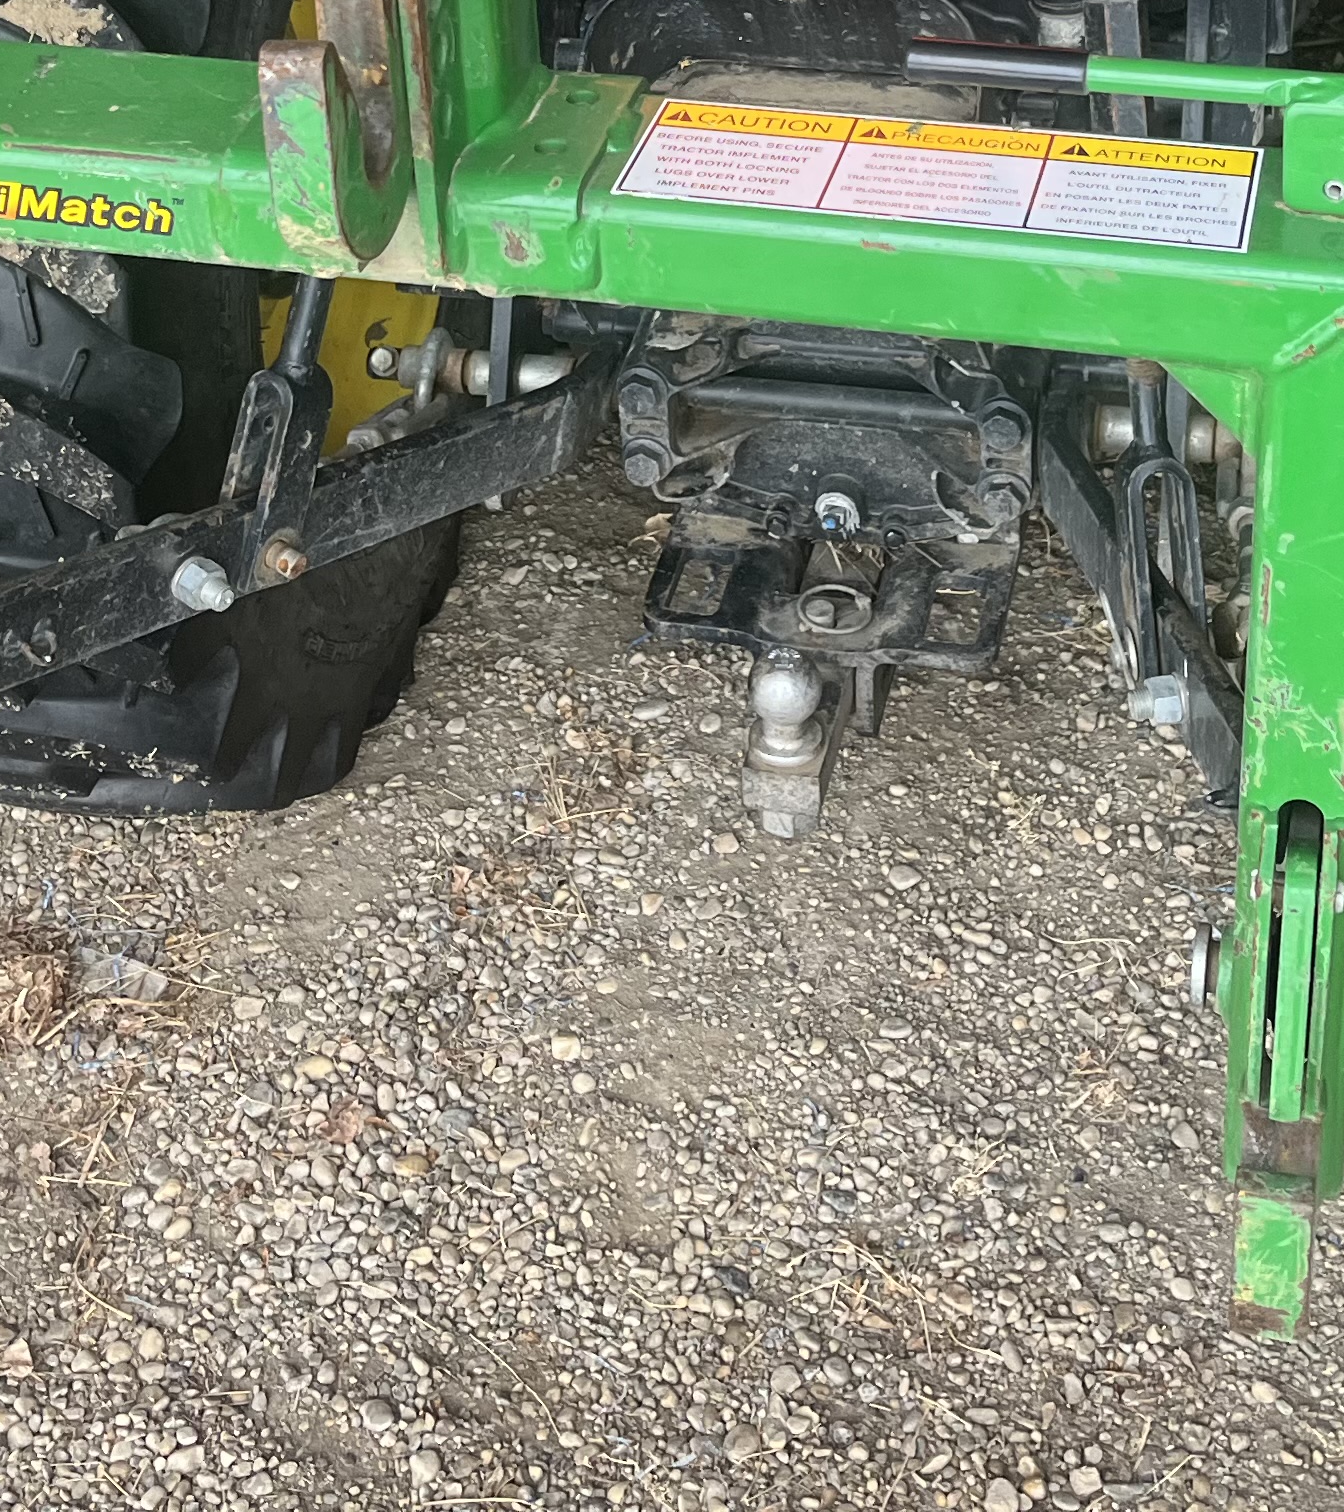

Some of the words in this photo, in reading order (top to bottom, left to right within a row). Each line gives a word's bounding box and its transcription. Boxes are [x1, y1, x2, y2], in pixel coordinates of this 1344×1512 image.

[698, 112, 832, 134] CAUTION
[657, 132, 712, 143] BEFORE
[766, 142, 824, 153] SECURE
[891, 131, 1040, 151] PRECAUCIÓN
[660, 144, 724, 156] TRACTOR
[728, 150, 811, 163] IMPLEMENT
[1094, 149, 1226, 168] ATTENTION
[657, 156, 691, 164] WITH
[695, 159, 733, 168] BOTH
[737, 164, 800, 174] LOCKING
[1069, 170, 1108, 178] AVANT
[655, 167, 693, 177] LUGS
[697, 172, 735, 181] OVER
[739, 176, 790, 185] LOWER
[656, 180, 737, 193] IMPLEMENT
[742, 187, 776, 196] PINS
[1136, 188, 1200, 198] TRACTEUR
[1060, 205, 1116, 215] FIXATION
[1065, 193, 1114, 202] POSANT
[1145, 200, 1178, 208] DEUX
[1183, 204, 1228, 213] PATTES
